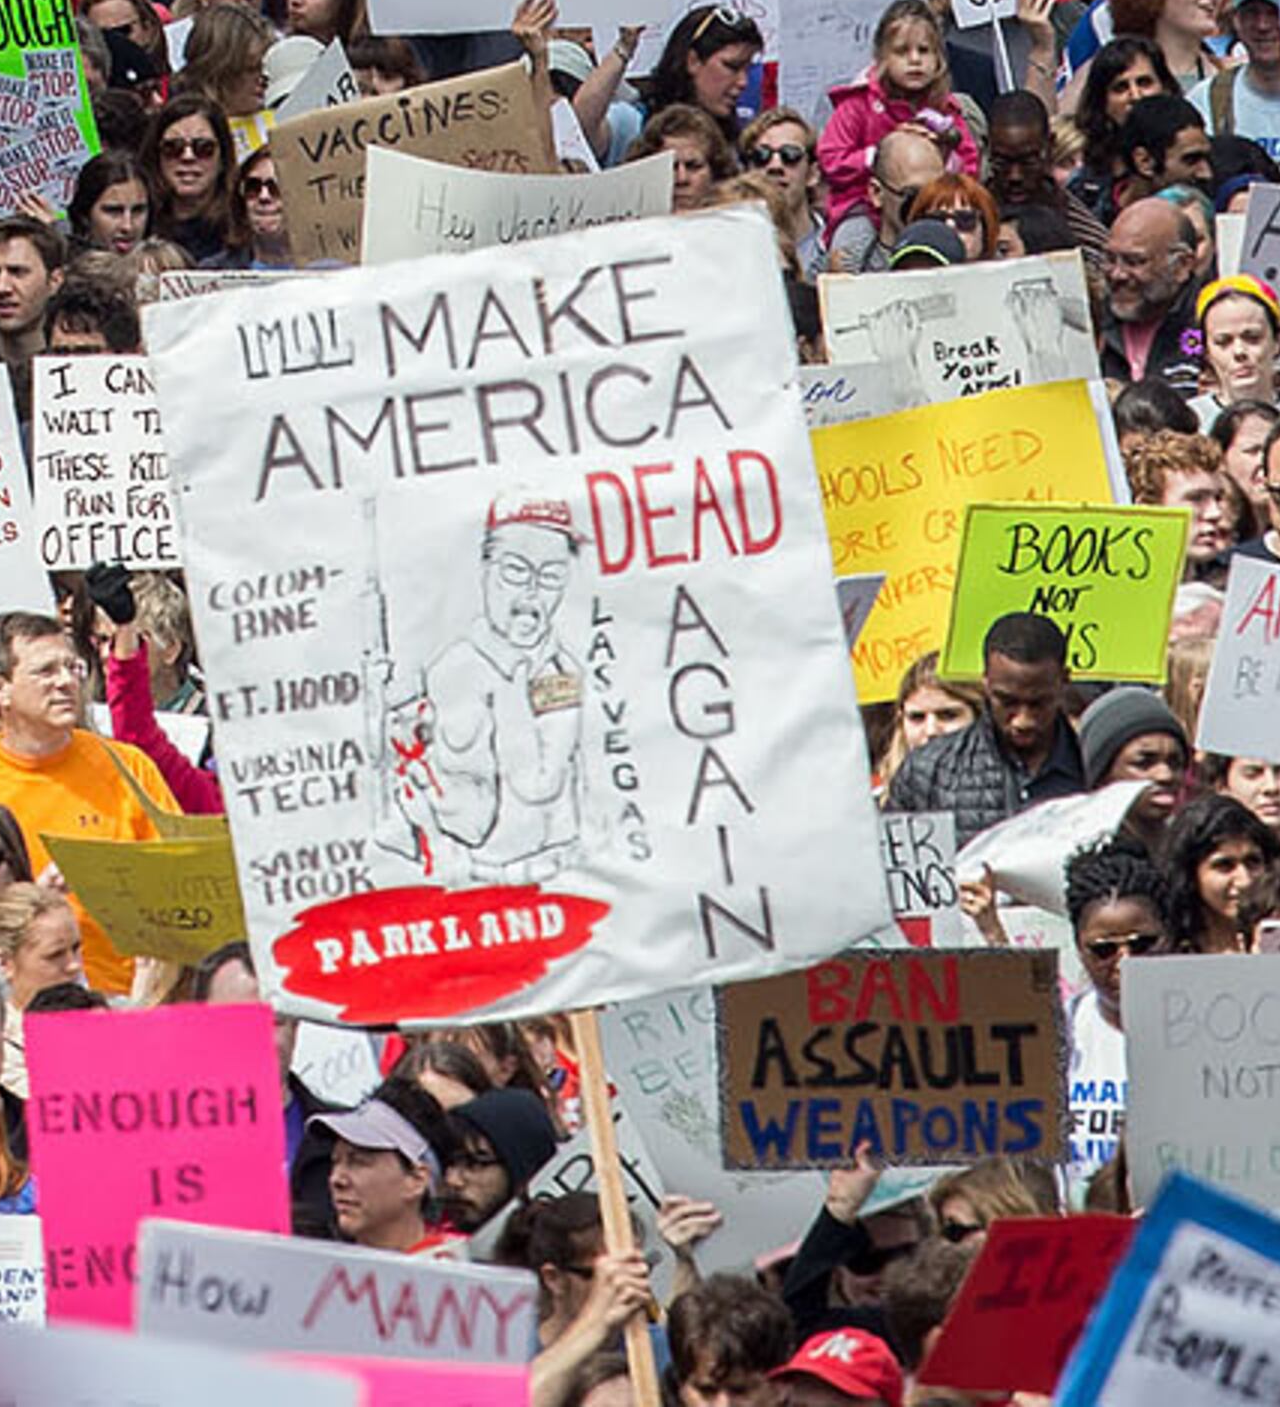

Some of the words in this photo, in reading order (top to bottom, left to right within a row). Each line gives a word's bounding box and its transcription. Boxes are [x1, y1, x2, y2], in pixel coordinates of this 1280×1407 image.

[379, 254, 688, 379] MAKE
[43, 406, 118, 439] WAIT
[254, 353, 735, 502] AMERICA
[937, 428, 1044, 481] NEED
[586, 448, 784, 578] DEAD
[997, 523, 1154, 580] BOOKS
[1028, 585, 1094, 615] NOT
[231, 739, 364, 786] VIRGINIA
[237, 772, 358, 817] TECH
[251, 839, 369, 880] SANDY
[263, 867, 376, 906] HOOK
[312, 898, 568, 975] PARKLAND
[805, 958, 963, 1023] BAN
[751, 1021, 1039, 1090] ASSAULT
[37, 1088, 259, 1136] ENOUGH
[737, 1099, 1045, 1160] WEAPONS
[148, 1165, 205, 1207] IS
